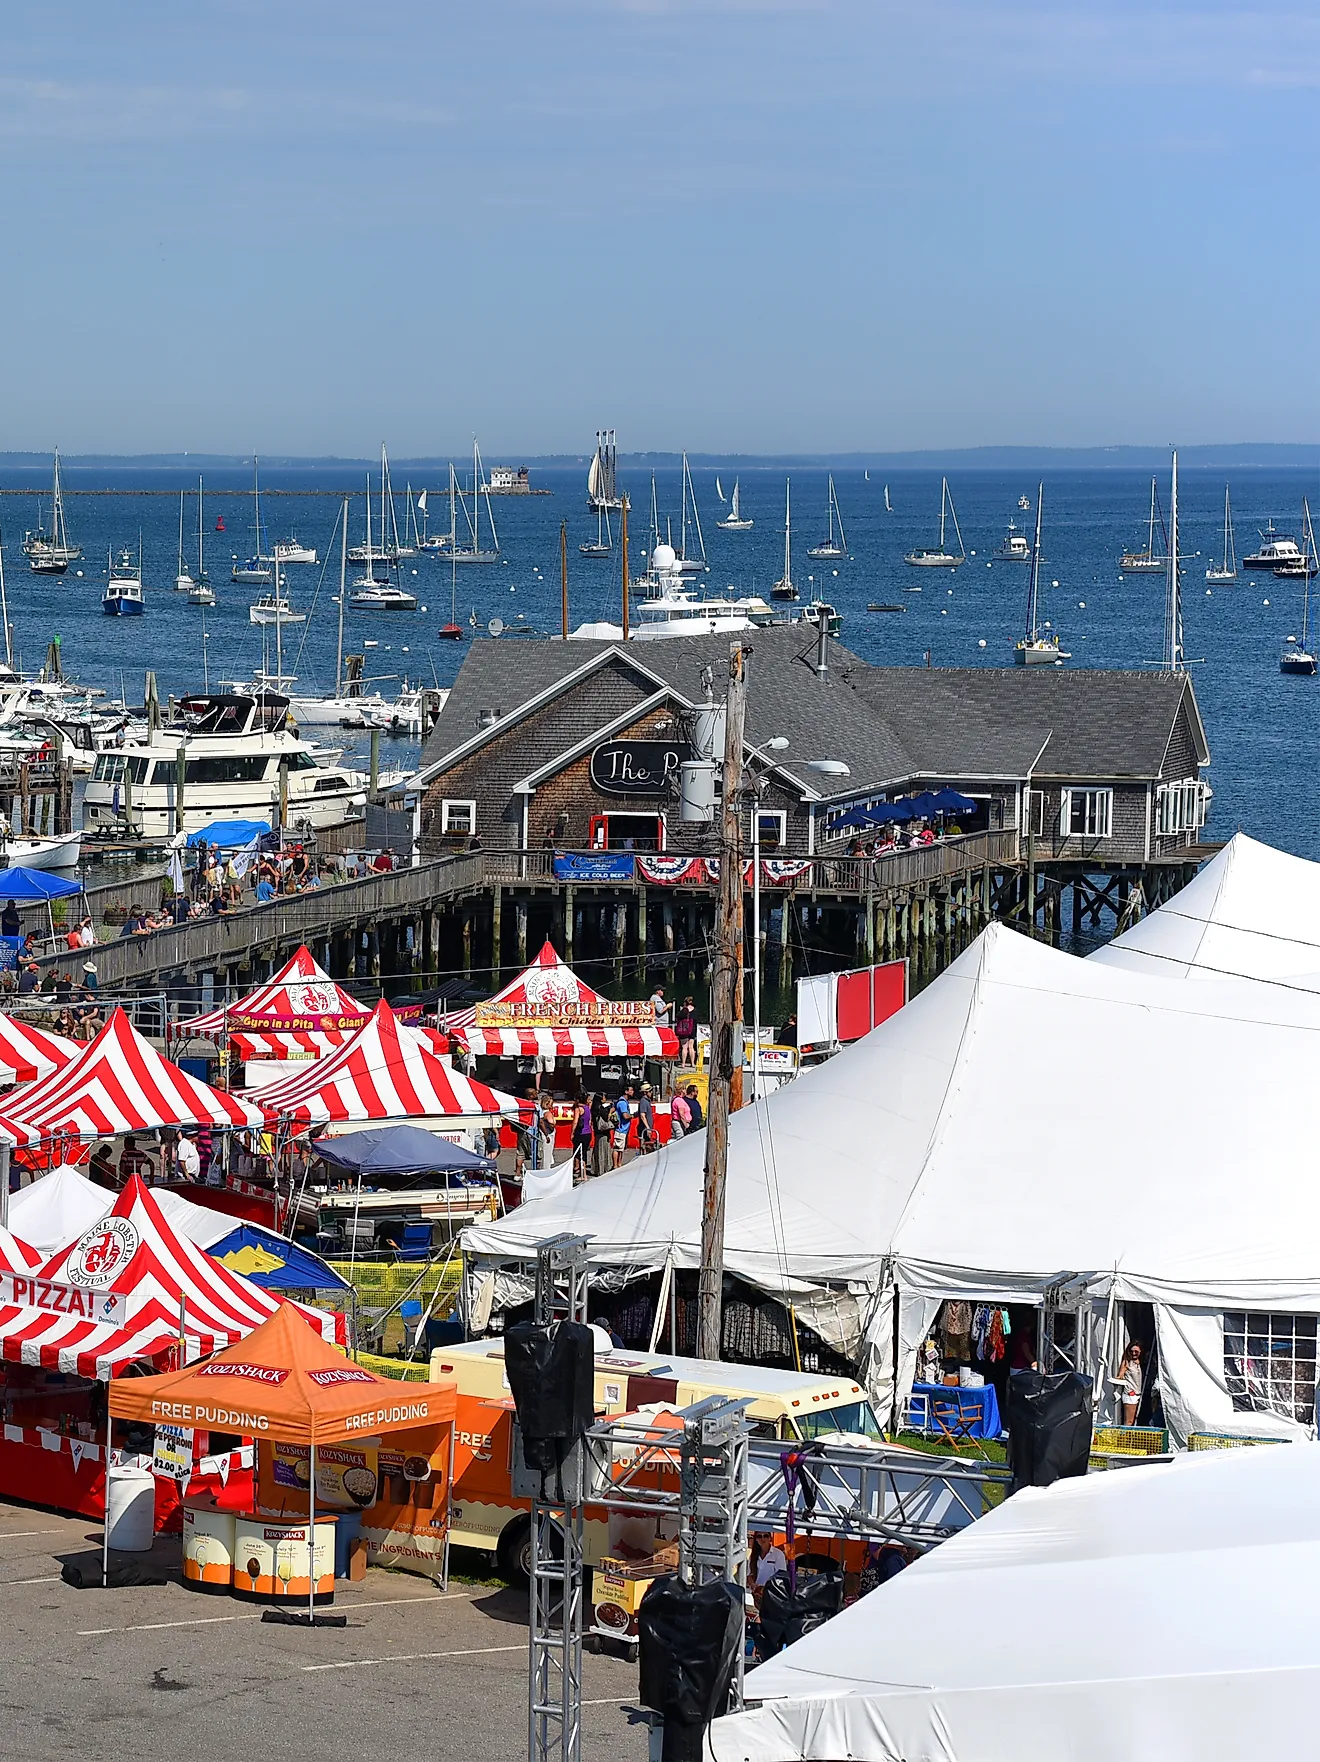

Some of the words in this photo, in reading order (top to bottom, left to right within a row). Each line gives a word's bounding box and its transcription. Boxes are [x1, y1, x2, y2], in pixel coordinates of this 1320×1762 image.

[602, 751, 651, 780] The
[510, 1002, 589, 1016] FRENCH
[597, 1001, 652, 1015] FRIES
[243, 1016, 270, 1028] Gyro
[284, 1020, 290, 1028] a
[292, 1019, 314, 1029] Pita
[338, 1017, 365, 1029] Giant
[558, 1016, 605, 1025] Chicken
[608, 1016, 653, 1025] Tenders
[287, 1052, 315, 1060] VEGGIE
[764, 1052, 780, 1060] ICE
[77, 1221, 110, 1252] MAINE
[113, 1220, 135, 1264] LOBSTER
[70, 1267, 111, 1284] FESTIVAL
[12, 1276, 95, 1318] PIZZA!
[98, 1315, 120, 1326] Domino's
[200, 1363, 283, 1382] KOZYSHACK
[312, 1369, 373, 1385] KOZYSHACK
[151, 1400, 192, 1420] FREE
[195, 1406, 269, 1430] PUDDING
[345, 1411, 375, 1431] FREE
[377, 1402, 428, 1423] PUDDING
[162, 1424, 184, 1437] PIZZA
[155, 1431, 192, 1450] PEPPERONI
[454, 1431, 492, 1448] FREE
[166, 1443, 176, 1453] OR
[154, 1457, 175, 1472] $2.00
[319, 1447, 365, 1466] KOZYSHACK
[175, 1467, 191, 1479] SLICE
